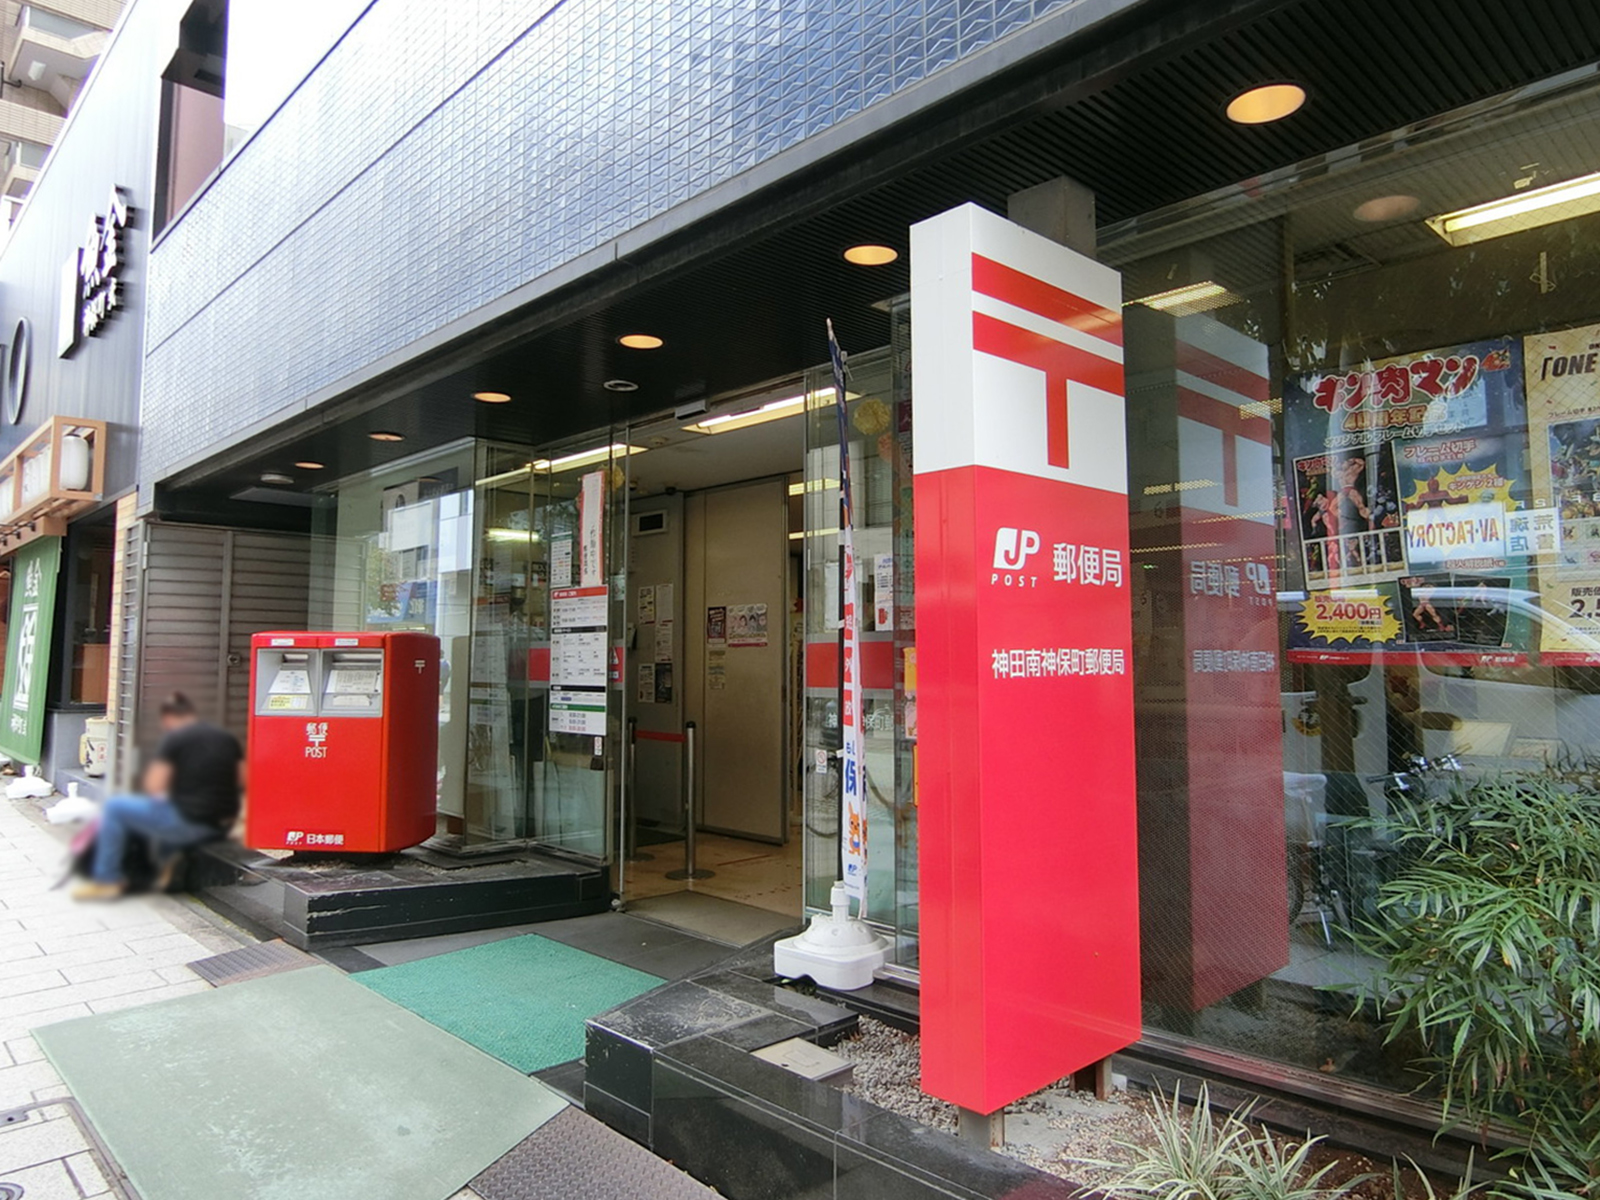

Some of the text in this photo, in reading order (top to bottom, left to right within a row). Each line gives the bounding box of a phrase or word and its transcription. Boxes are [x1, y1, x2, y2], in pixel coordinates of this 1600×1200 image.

[1314, 356, 1479, 413] キン肉マン
[1404, 438, 1477, 459] フレーム切手
[993, 527, 1041, 571] JP
[1053, 543, 1123, 588] 郵便局
[991, 573, 1038, 588] POST
[1316, 603, 1381, 621] 2,400円
[991, 648, 1125, 679] 神田南神保町郵便局
[306, 722, 328, 736] 郵便
[305, 746, 328, 758] POST
[306, 833, 344, 846] 日本郵便
